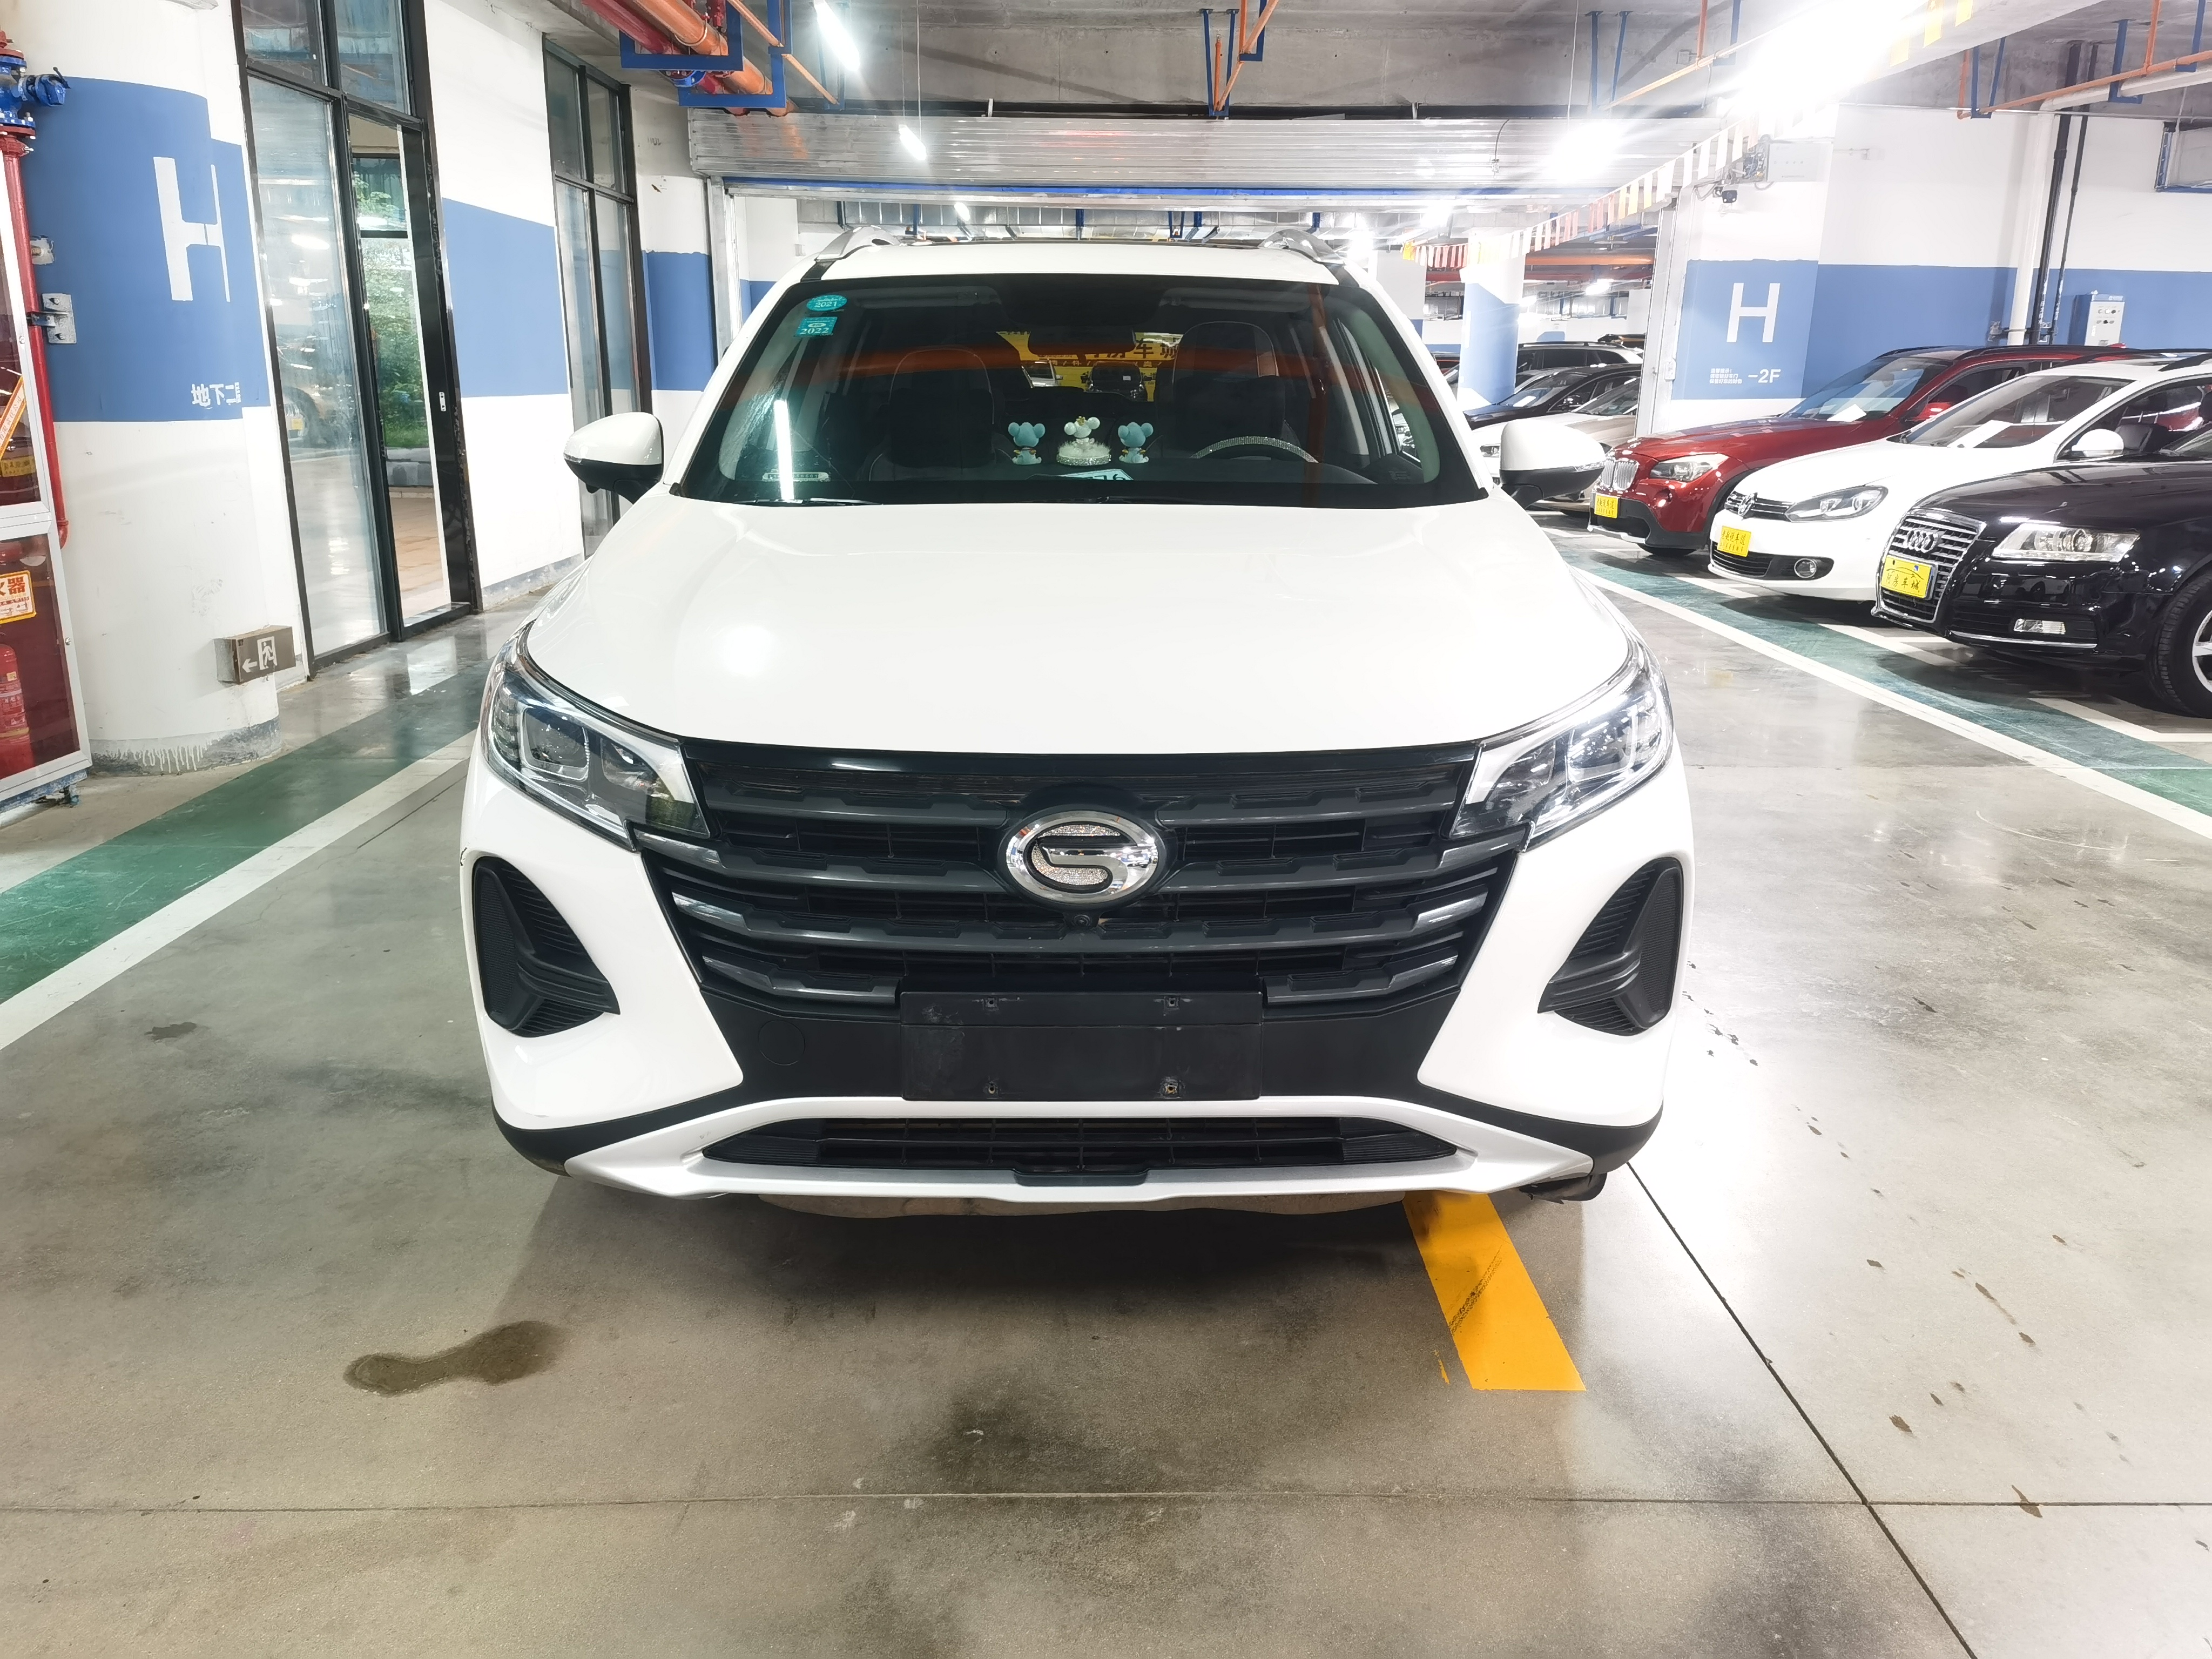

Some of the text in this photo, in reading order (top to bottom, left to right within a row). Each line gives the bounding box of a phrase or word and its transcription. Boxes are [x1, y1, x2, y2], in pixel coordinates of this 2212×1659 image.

[153, 157, 231, 302] H
[1727, 282, 1781, 342] H
[1748, 369, 1781, 383] -2F
